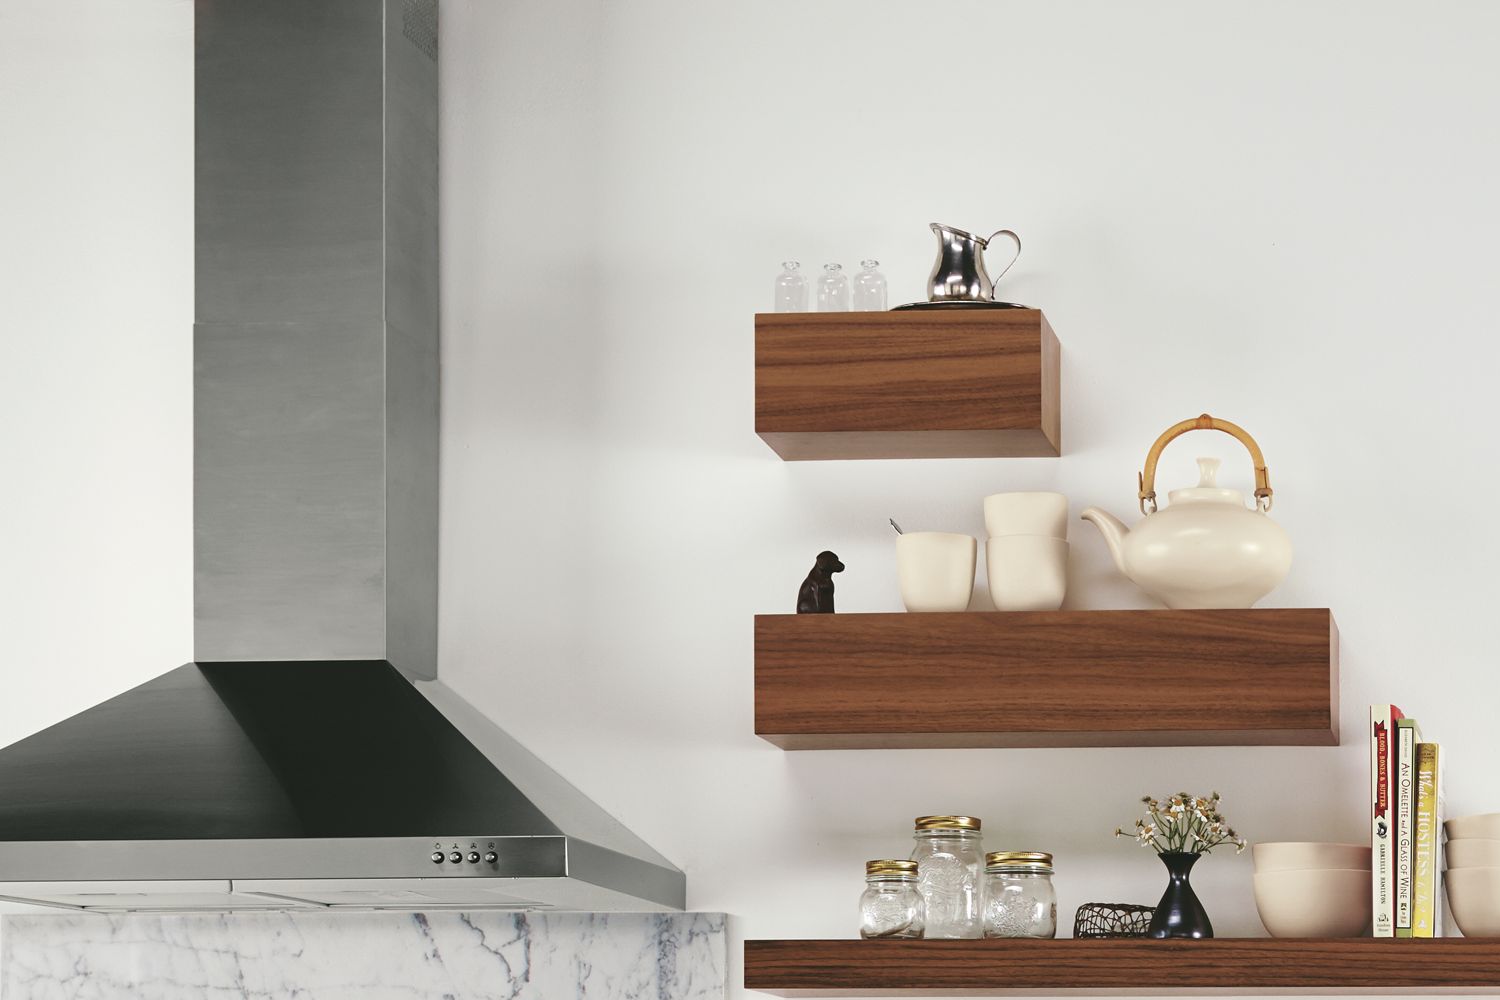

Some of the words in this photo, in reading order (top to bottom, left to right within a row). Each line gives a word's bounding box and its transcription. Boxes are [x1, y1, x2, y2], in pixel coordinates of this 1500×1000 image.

[1401, 762, 1410, 776] AN
[1419, 771, 1432, 800] What's
[1401, 779, 1410, 818] OMELETTE
[1401, 839, 1409, 862] GLASS
[1417, 811, 1430, 877] HOSTESS
[1400, 865, 1407, 875] OF
[1400, 877, 1409, 899] WINE
